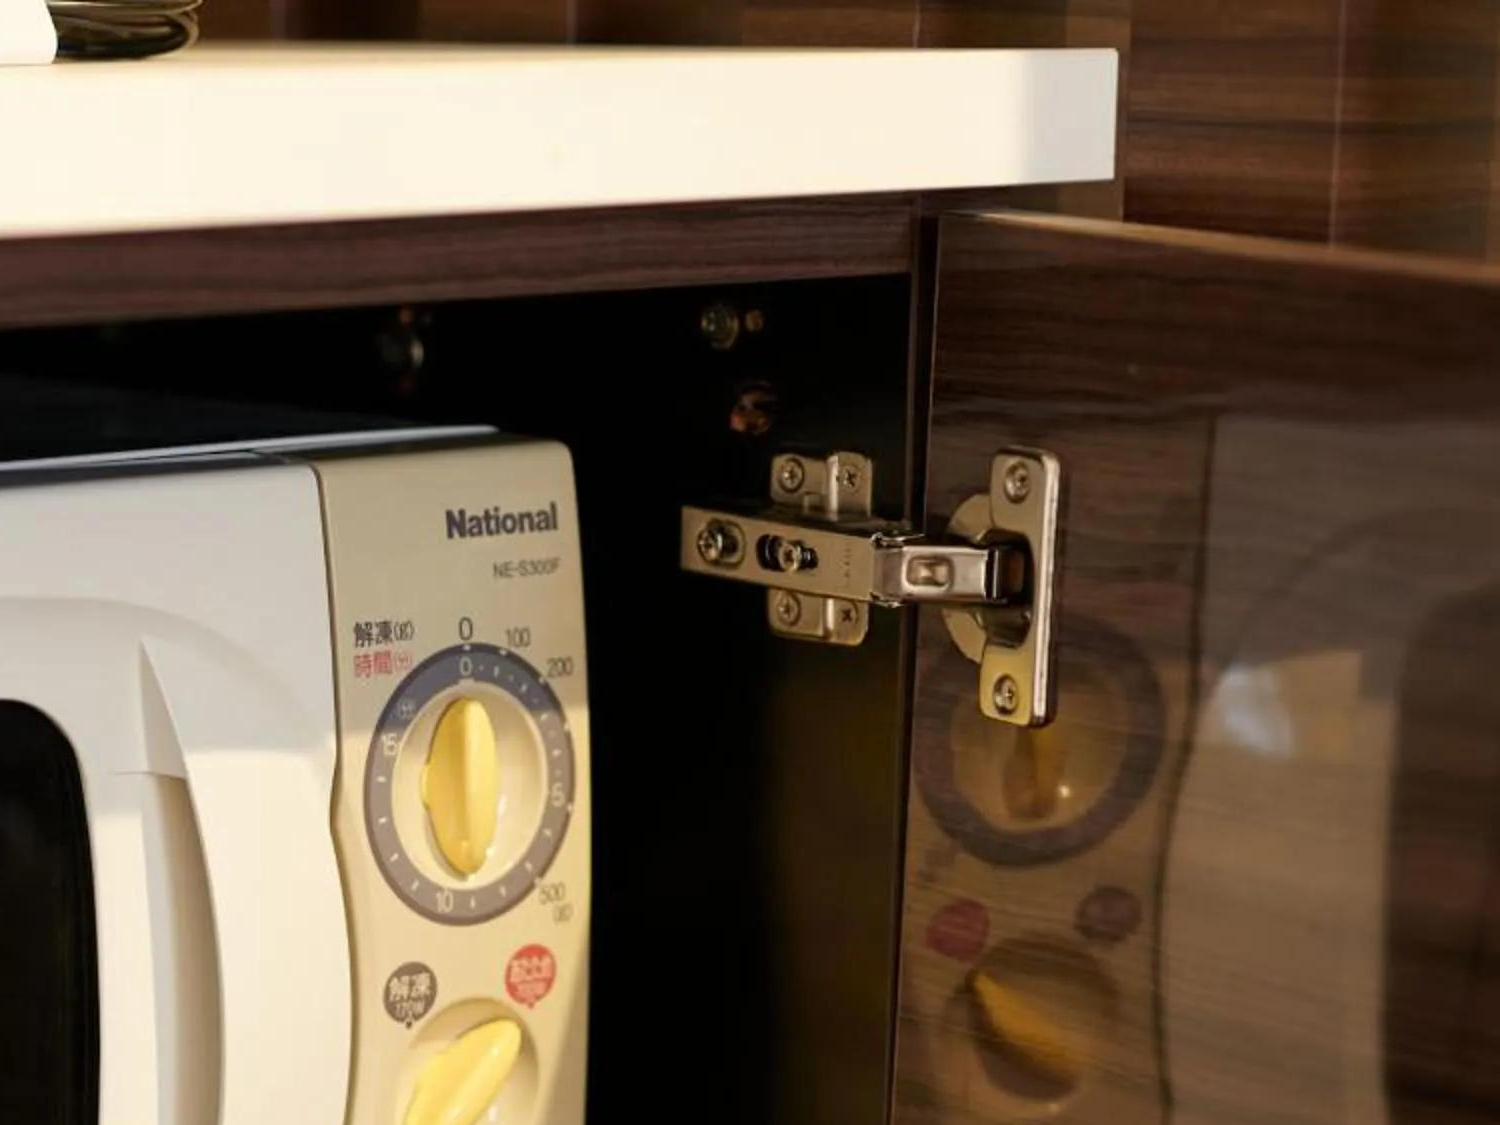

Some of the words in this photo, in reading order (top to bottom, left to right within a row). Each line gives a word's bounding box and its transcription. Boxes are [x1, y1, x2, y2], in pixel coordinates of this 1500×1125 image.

[445, 502, 558, 539] National
[493, 557, 561, 578] NE-S300F
[458, 617, 474, 641] 0
[505, 627, 530, 647] 100
[459, 656, 473, 676] 0
[546, 657, 573, 678] 200
[381, 733, 398, 757] 15
[436, 889, 454, 913] 10
[539, 881, 566, 905] 500
